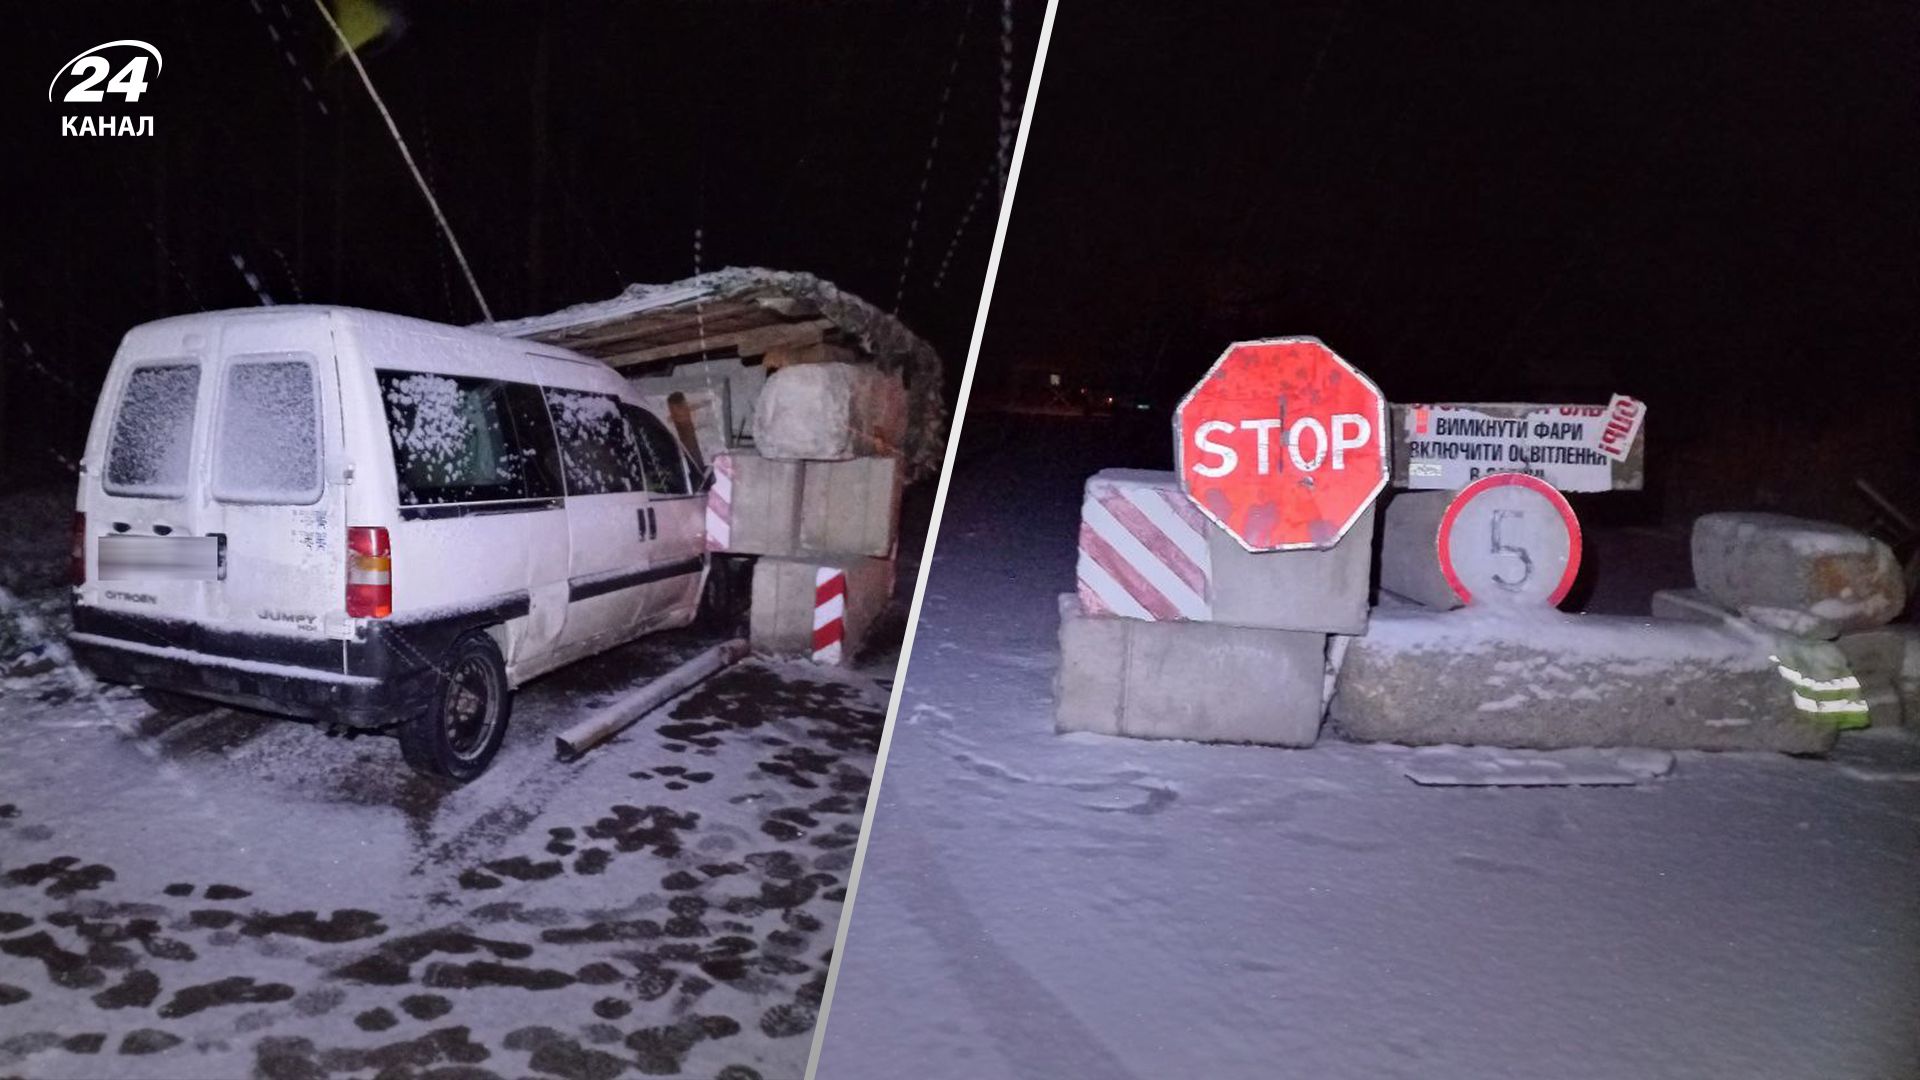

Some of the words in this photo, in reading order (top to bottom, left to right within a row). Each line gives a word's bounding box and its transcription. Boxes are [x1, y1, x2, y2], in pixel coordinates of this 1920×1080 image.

[1436, 417, 1528, 438] ВИМКНУТИ
[1534, 422, 1583, 440] ФАРИ
[1192, 413, 1371, 478] STOP
[1409, 441, 1503, 461] ВКЛЮЧИТИ
[1491, 510, 1533, 592] 5
[257, 609, 317, 624] JUMPY
